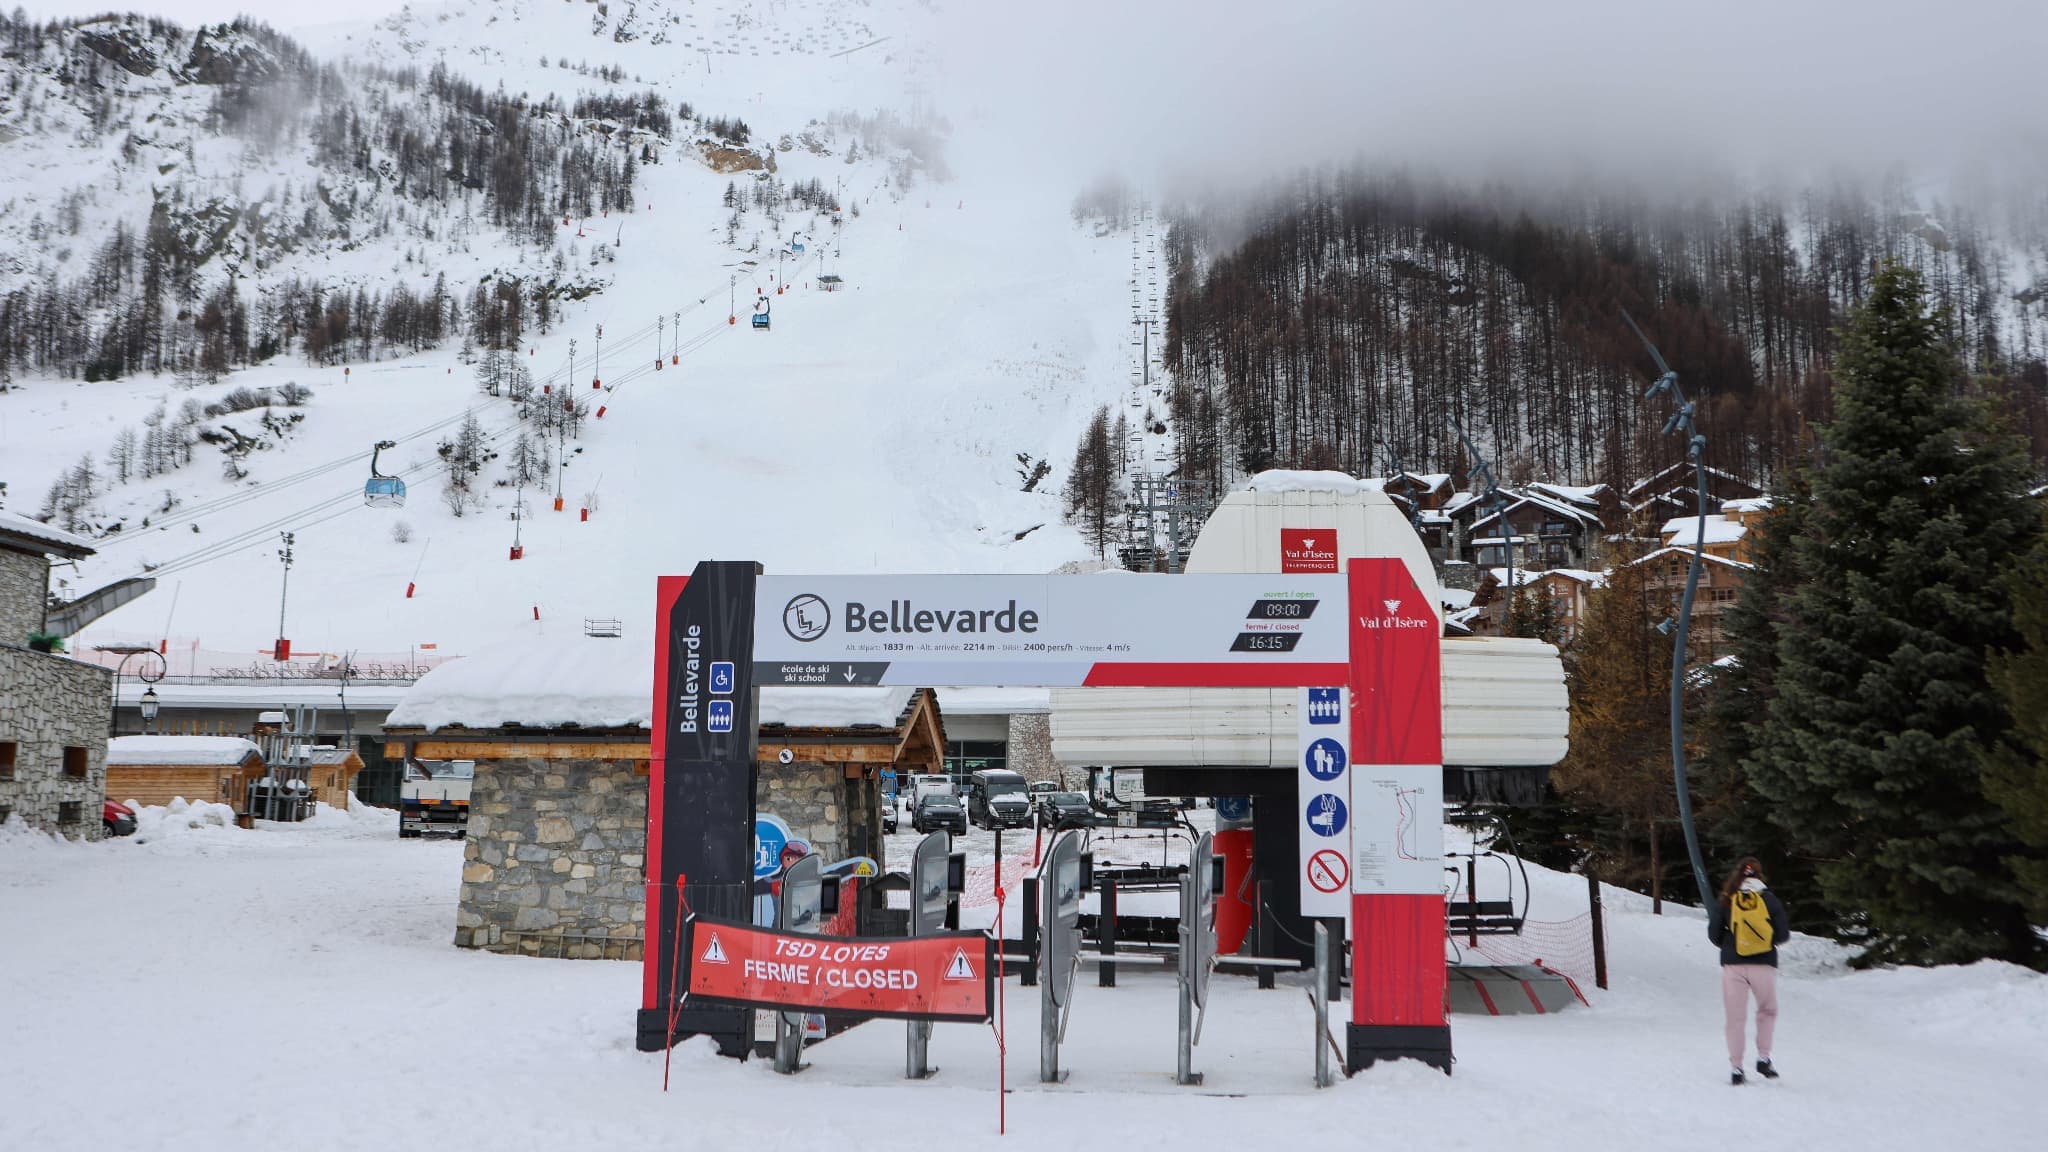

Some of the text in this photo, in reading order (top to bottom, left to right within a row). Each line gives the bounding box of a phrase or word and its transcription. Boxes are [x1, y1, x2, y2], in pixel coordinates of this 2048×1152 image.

[1286, 550, 1300, 558] Val
[1296, 592, 1315, 600] open
[1266, 603, 1301, 617] 09:00
[845, 599, 1039, 634] Bellevarde
[1245, 623, 1268, 631] fermé
[1275, 623, 1300, 631] closed
[1359, 616, 1429, 629] Val d'Isère
[883, 643, 904, 651] 1833
[963, 643, 985, 651] 2214
[1023, 643, 1046, 651] 2400
[1047, 643, 1073, 653] pers/h
[1106, 643, 1113, 652] 4
[1114, 643, 1131, 652] m/s
[1249, 636, 1284, 650] 16:15
[781, 664, 830, 673] école de ski
[680, 625, 701, 733] Bellevarde
[784, 673, 826, 682] ski school
[1321, 689, 1328, 698] 4
[775, 939, 891, 963] TSD LOYES
[743, 959, 811, 985] FERME
[826, 968, 919, 990] CLOSED
